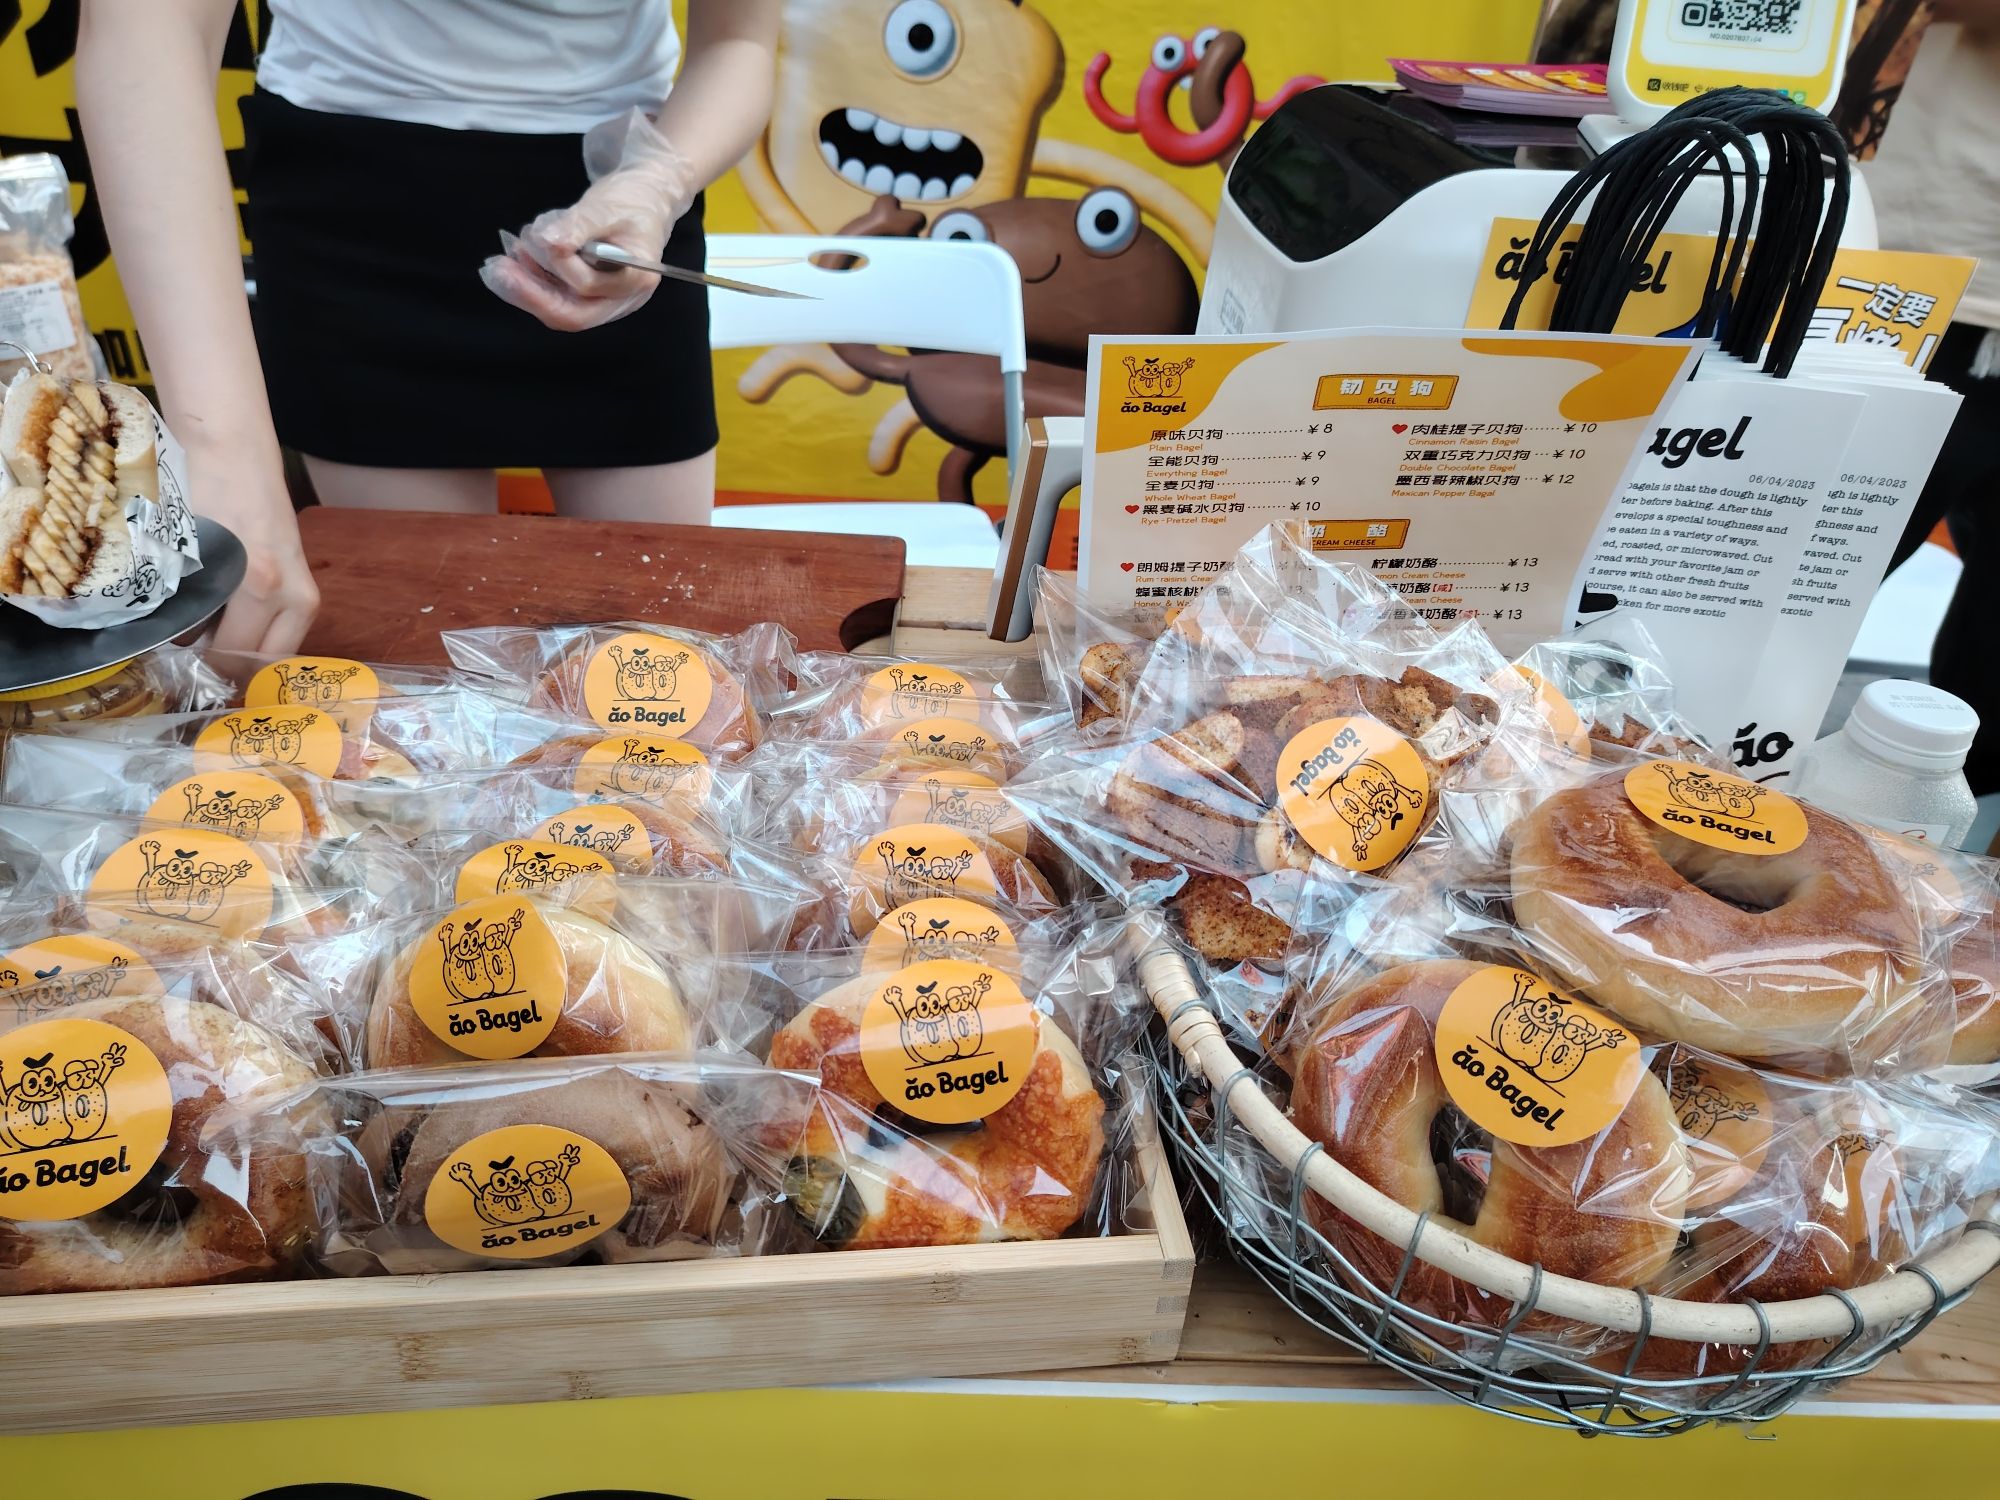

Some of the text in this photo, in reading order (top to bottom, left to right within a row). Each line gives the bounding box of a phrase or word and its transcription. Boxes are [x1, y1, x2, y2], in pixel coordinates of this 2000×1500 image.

[1837, 276, 1939, 328] 一定要
[1367, 397, 1397, 405] BAGEL
[1142, 402, 1187, 415] Bagel
[1150, 428, 1224, 441] 原味贝狗
[1411, 424, 1523, 436] 肉桂提子贝狗
[1149, 443, 1204, 453] Plain Bagel
[1408, 437, 1520, 447] Cinnamon Raisin Bagel
[1148, 455, 1219, 467] 全能贝狗
[1403, 450, 1531, 461] 双重巧克力贝狗
[1146, 468, 1228, 478] Everything Bagel
[1399, 463, 1516, 473] Double Chocolate Bagel
[1145, 480, 1215, 491] 全麦贝狗
[1395, 474, 1520, 486] 墨西哥辣椒贝狗
[1748, 474, 1816, 490] 06/04/2023
[1840, 473, 1907, 489] 06/04/2023
[1144, 493, 1237, 502] Whole Wheat Bagel
[1391, 489, 1430, 497] Mexican
[1433, 489, 1466, 498] Pepper
[1662, 483, 1672, 491] is
[1673, 484, 1696, 492] that
[1698, 485, 1718, 495] the
[1719, 487, 1755, 500] dough
[1757, 492, 1768, 501] is
[1769, 493, 1808, 507] lightly
[1849, 491, 1899, 506] is lightly
[1142, 502, 1245, 515] 黑麦碱水贝狗
[1640, 496, 1673, 506] before
[1674, 498, 1714, 511] baking.
[1717, 502, 1749, 514] After
[1750, 506, 1773, 517] this
[1841, 506, 1863, 516] this
[1200, 516, 1227, 525] Bagel
[1665, 514, 1705, 525] special
[1706, 517, 1764, 532] toughness
[1765, 525, 1788, 535] and
[1856, 524, 1879, 534] and
[1618, 526, 1648, 535] eaten
[1650, 526, 1661, 536] in
[1673, 530, 1713, 542] variety
[1715, 533, 1728, 543] of
[1727, 537, 1760, 547] ways.
[1817, 537, 1849, 547] ways.
[1620, 541, 1663, 552] roasted,
[1681, 546, 1750, 561] microwaved.
[1752, 553, 1774, 564] Cut
[1842, 553, 1863, 563] Cut
[1371, 558, 1438, 569] 柠檬奶酪
[1625, 555, 1648, 565] with
[1649, 557, 1678, 567] your
[1679, 560, 1722, 573] favorite
[1721, 565, 1744, 575] jam
[1746, 569, 1760, 577] or
[1809, 564, 1833, 576] jam
[1835, 568, 1849, 576] or
[1401, 571, 1466, 579] Cream Cheese
[1597, 568, 1627, 577] serve
[1629, 570, 1653, 580] with
[1656, 573, 1686, 583] other
[1687, 576, 1717, 587] fresh
[1717, 579, 1750, 591] fruits
[1806, 578, 1838, 590] fruits
[1429, 595, 1463, 604] Cheese
[1628, 584, 1637, 592] it
[1639, 586, 1658, 595] can
[1660, 588, 1683, 598] also
[1685, 590, 1698, 600] be
[1699, 593, 1737, 605] served
[1739, 597, 1763, 608] with
[1787, 592, 1851, 607] served with
[1133, 600, 1160, 608] Honey
[1645, 601, 1661, 611] for
[1663, 605, 1691, 614] more
[1693, 606, 1726, 618] exotic
[1780, 607, 1813, 617] exotic
[634, 706, 686, 727] Bagel
[1290, 746, 1346, 797] Bagel
[1698, 814, 1776, 845] Bagel
[476, 999, 543, 1032] Bagel
[936, 1060, 1009, 1095] Bagel
[1485, 1065, 1565, 1131] Bagel
[34, 1145, 131, 1188] Bagel
[517, 1214, 600, 1242] Bagel
